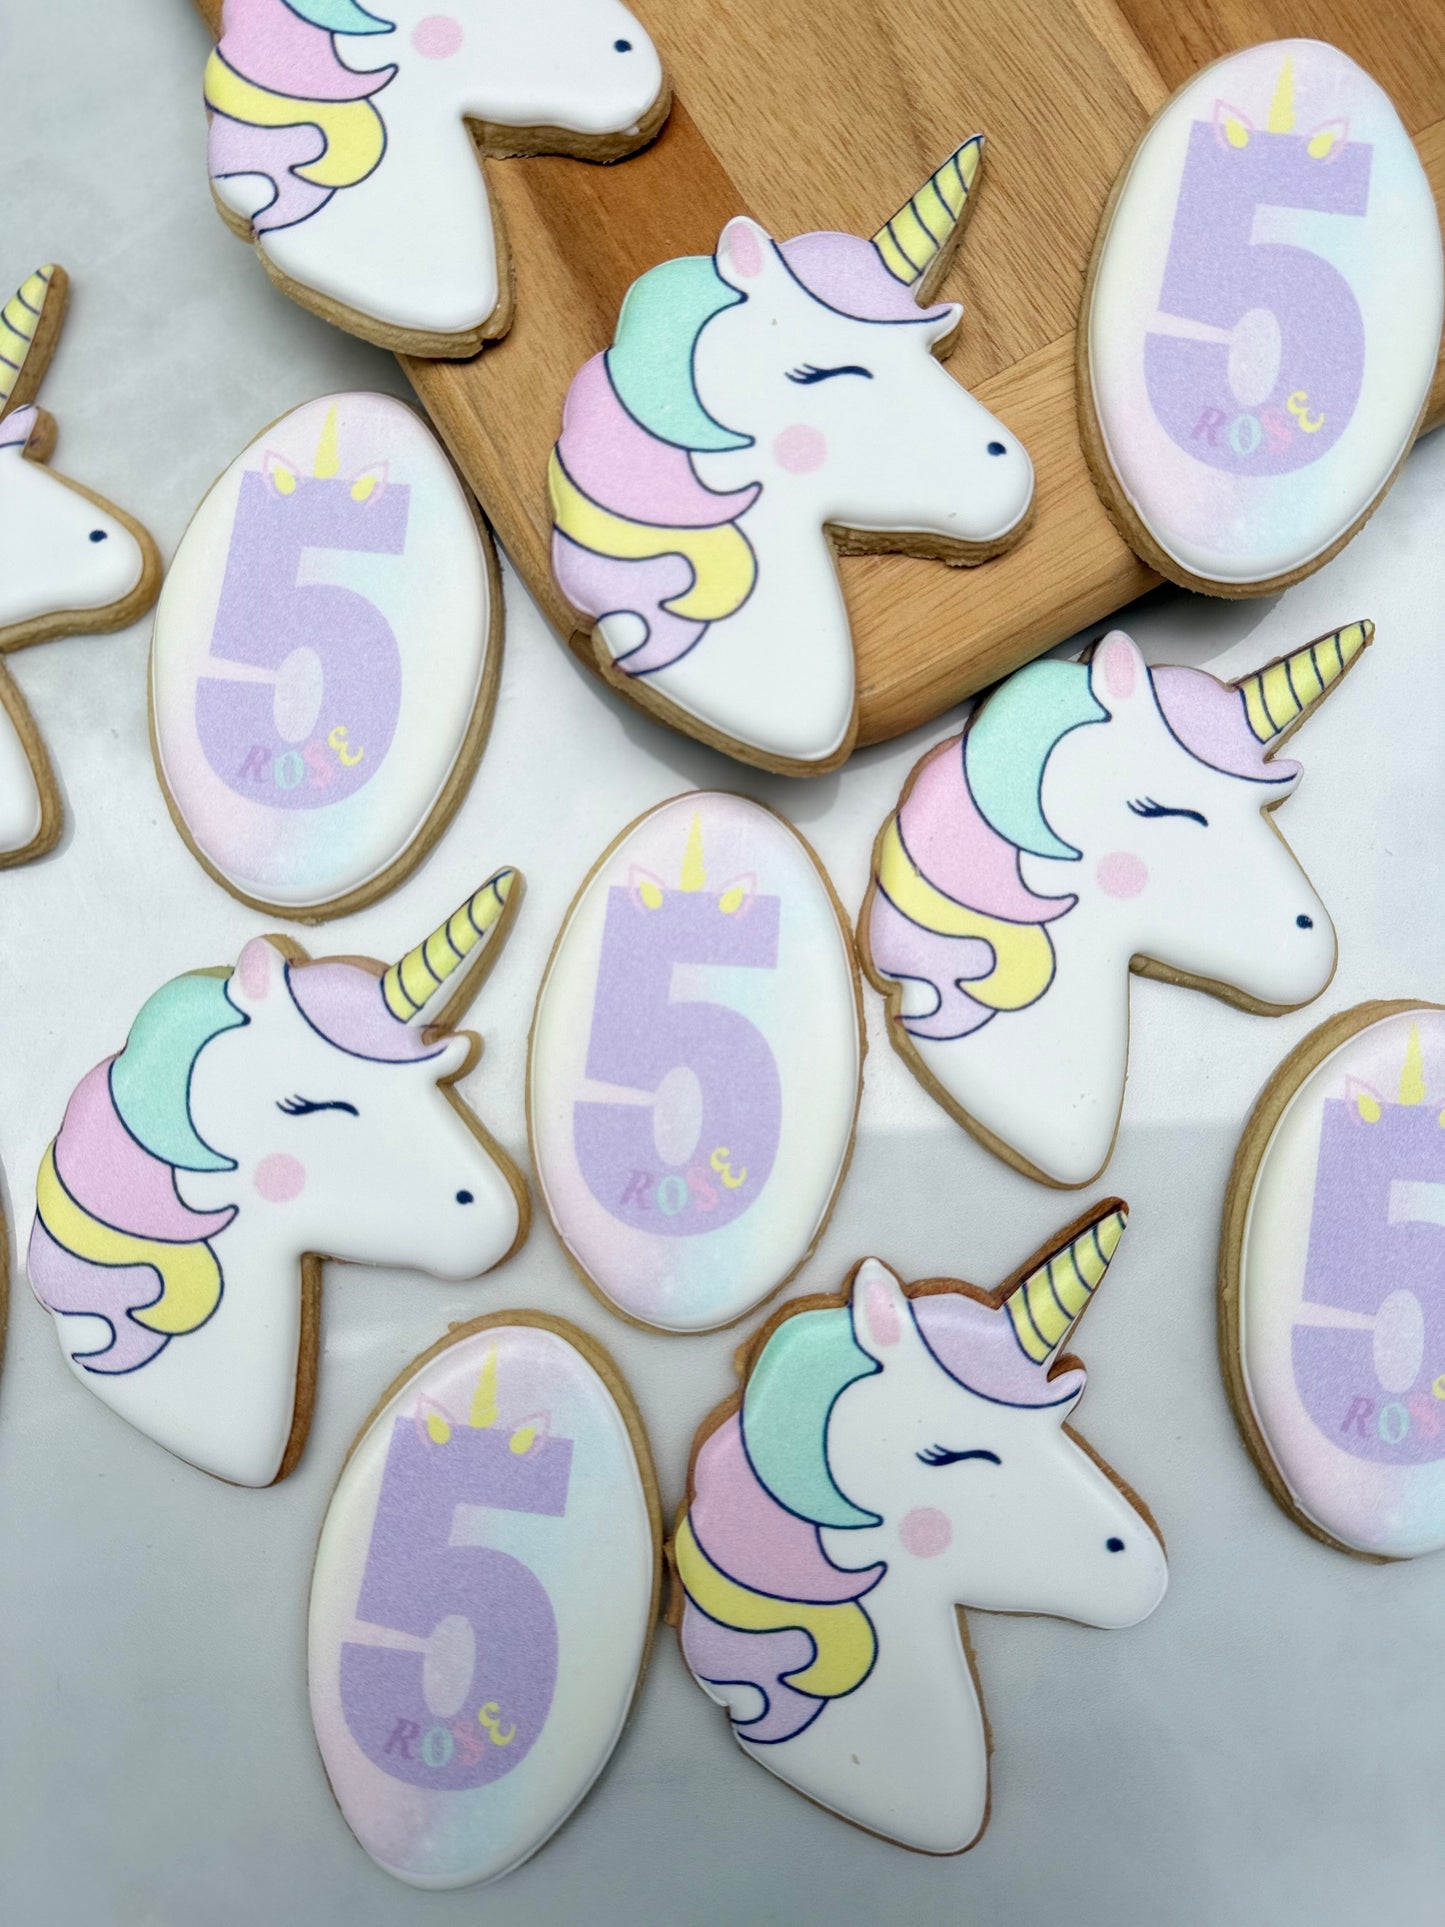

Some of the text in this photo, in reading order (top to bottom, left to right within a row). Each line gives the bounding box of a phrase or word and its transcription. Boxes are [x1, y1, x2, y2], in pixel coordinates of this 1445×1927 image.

[1144, 120, 1374, 477] 5
[1190, 390, 1325, 457] ROSE
[195, 470, 411, 811] 5
[237, 725, 364, 790] ROSE
[572, 886, 782, 1237] 5
[619, 1146, 748, 1217] ROSE
[1291, 1097, 1445, 1466] 5
[339, 1416, 575, 1791] 5
[382, 1702, 516, 1768] ROSE
